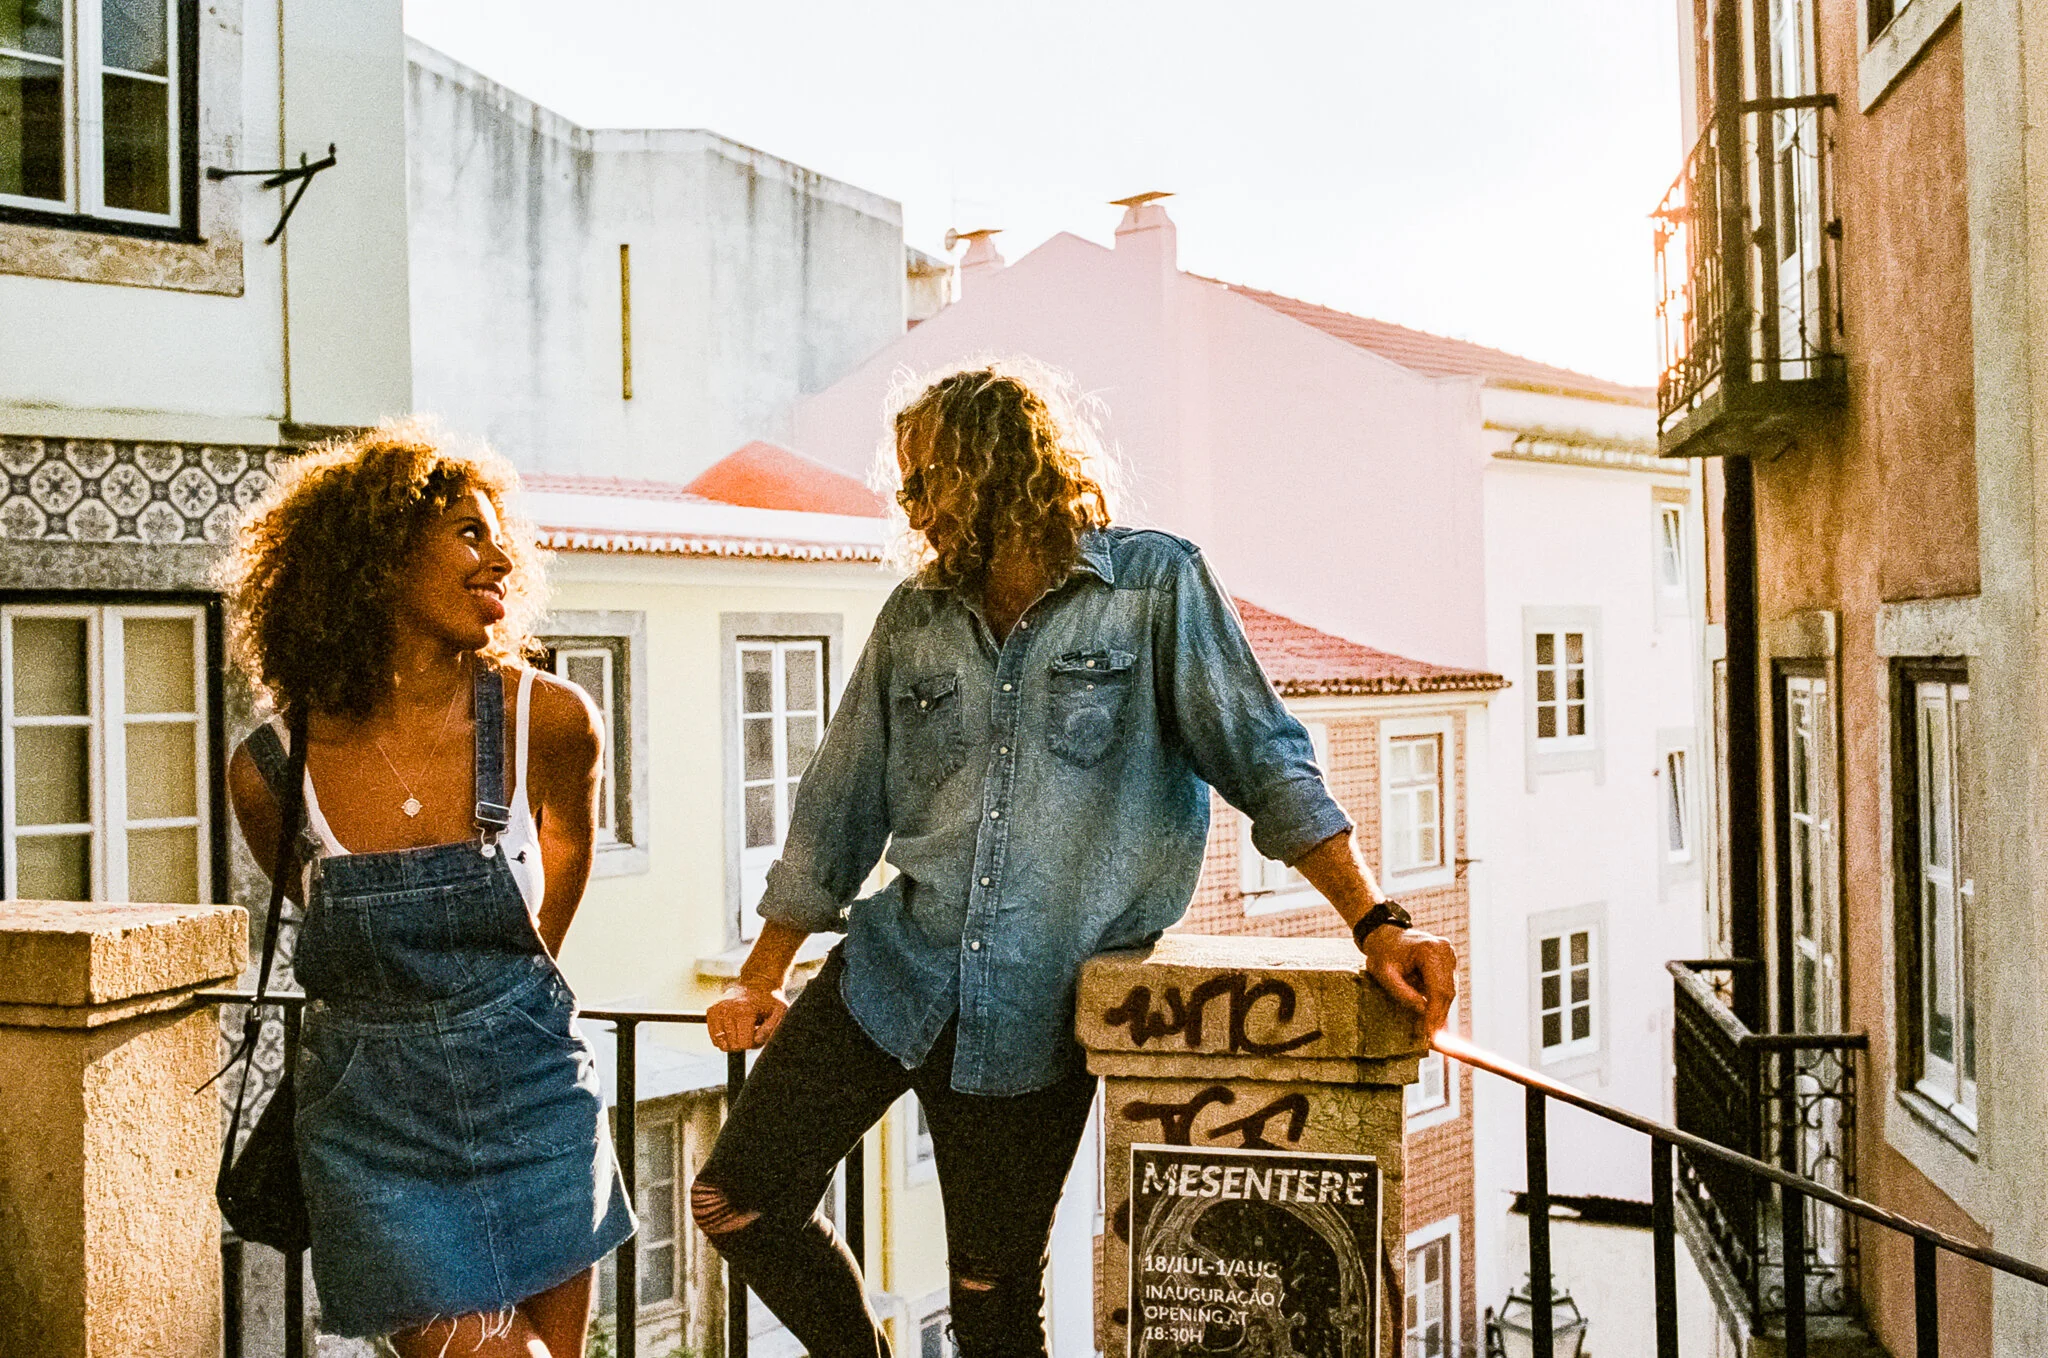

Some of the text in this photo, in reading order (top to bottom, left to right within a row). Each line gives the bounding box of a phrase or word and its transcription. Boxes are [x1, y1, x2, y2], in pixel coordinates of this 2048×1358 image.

[1141, 1161, 1369, 1206] MESENTERE
[1144, 1305, 1249, 1326] OPENING AT
[1145, 1326, 1203, 1344] 18:30H
